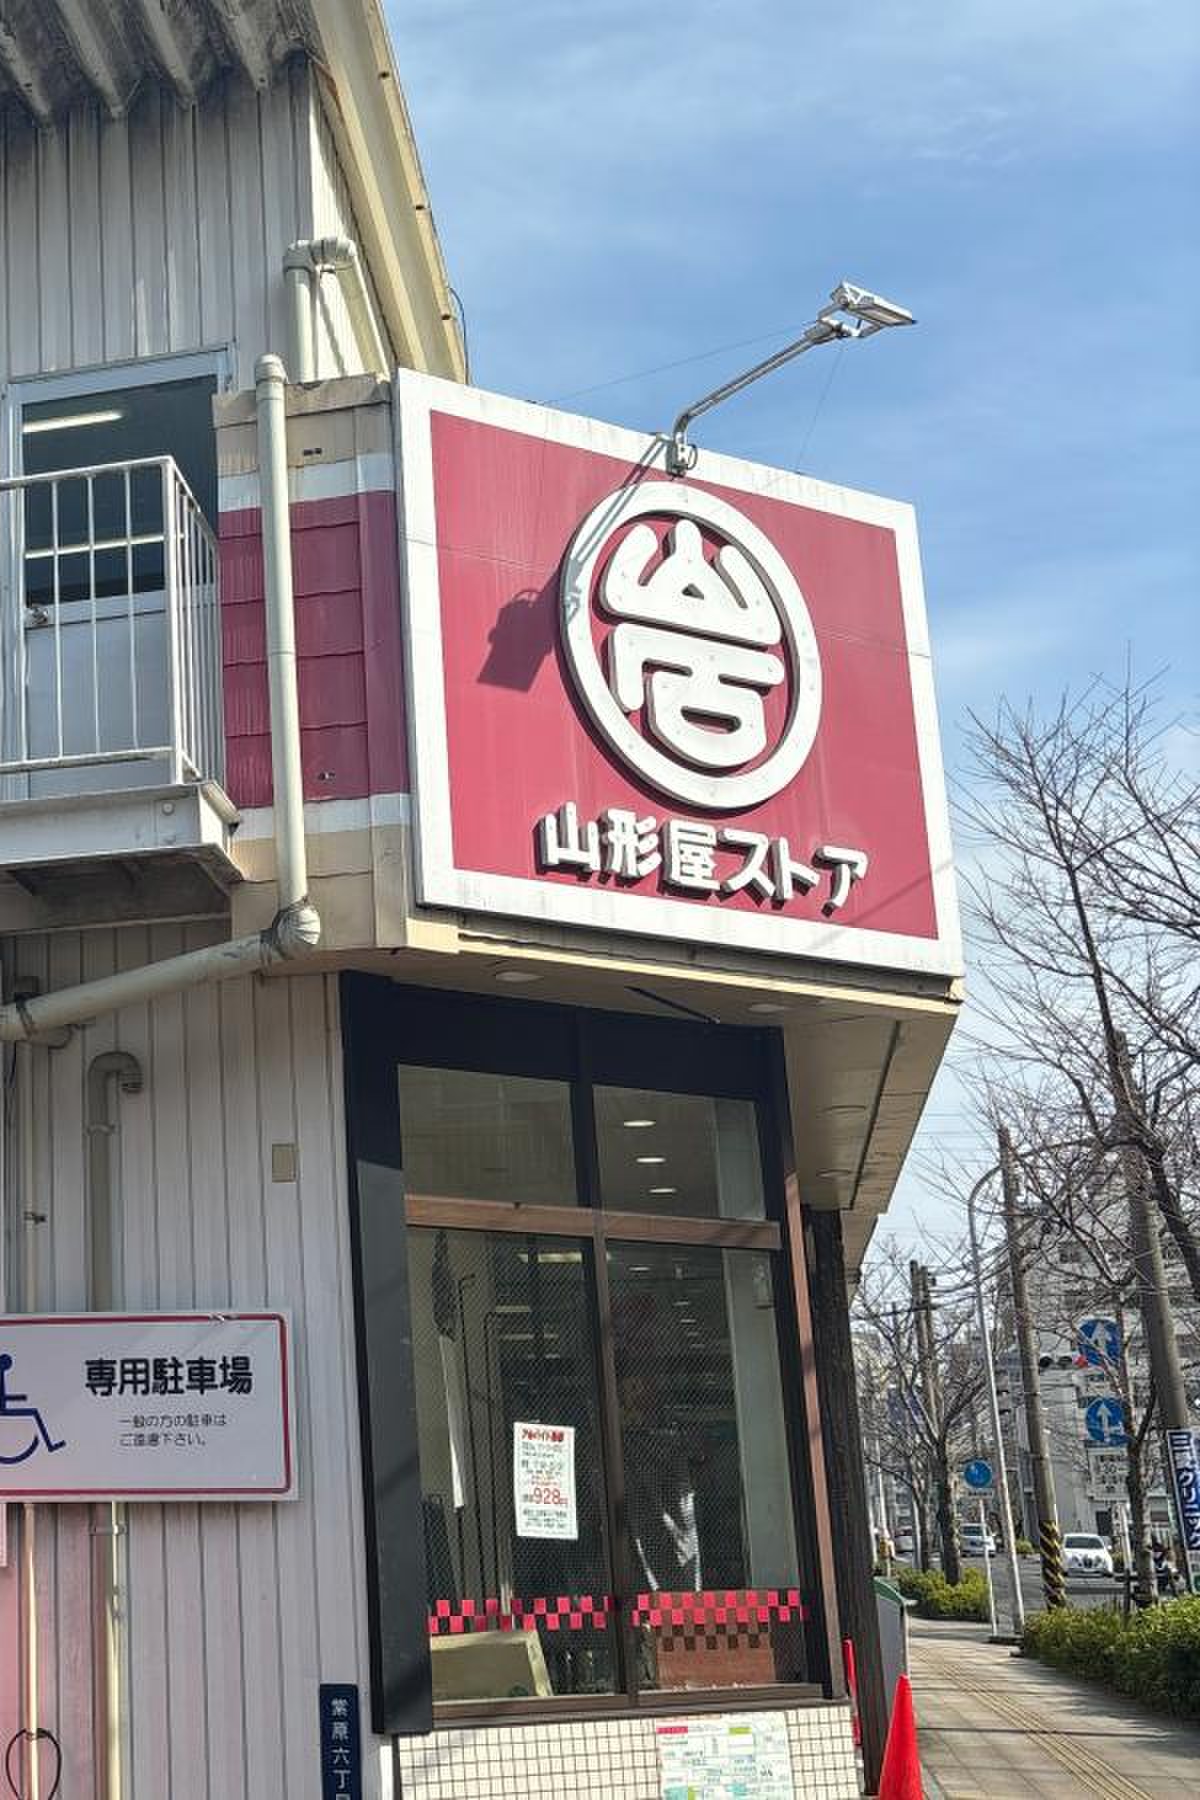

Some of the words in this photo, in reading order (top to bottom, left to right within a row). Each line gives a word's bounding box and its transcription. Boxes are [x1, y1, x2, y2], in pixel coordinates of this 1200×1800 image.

[536, 800, 869, 916] 山形屋ストア
[85, 1356, 253, 1396] 専用駐車場
[118, 1408, 228, 1428] 一般の方の駐車は
